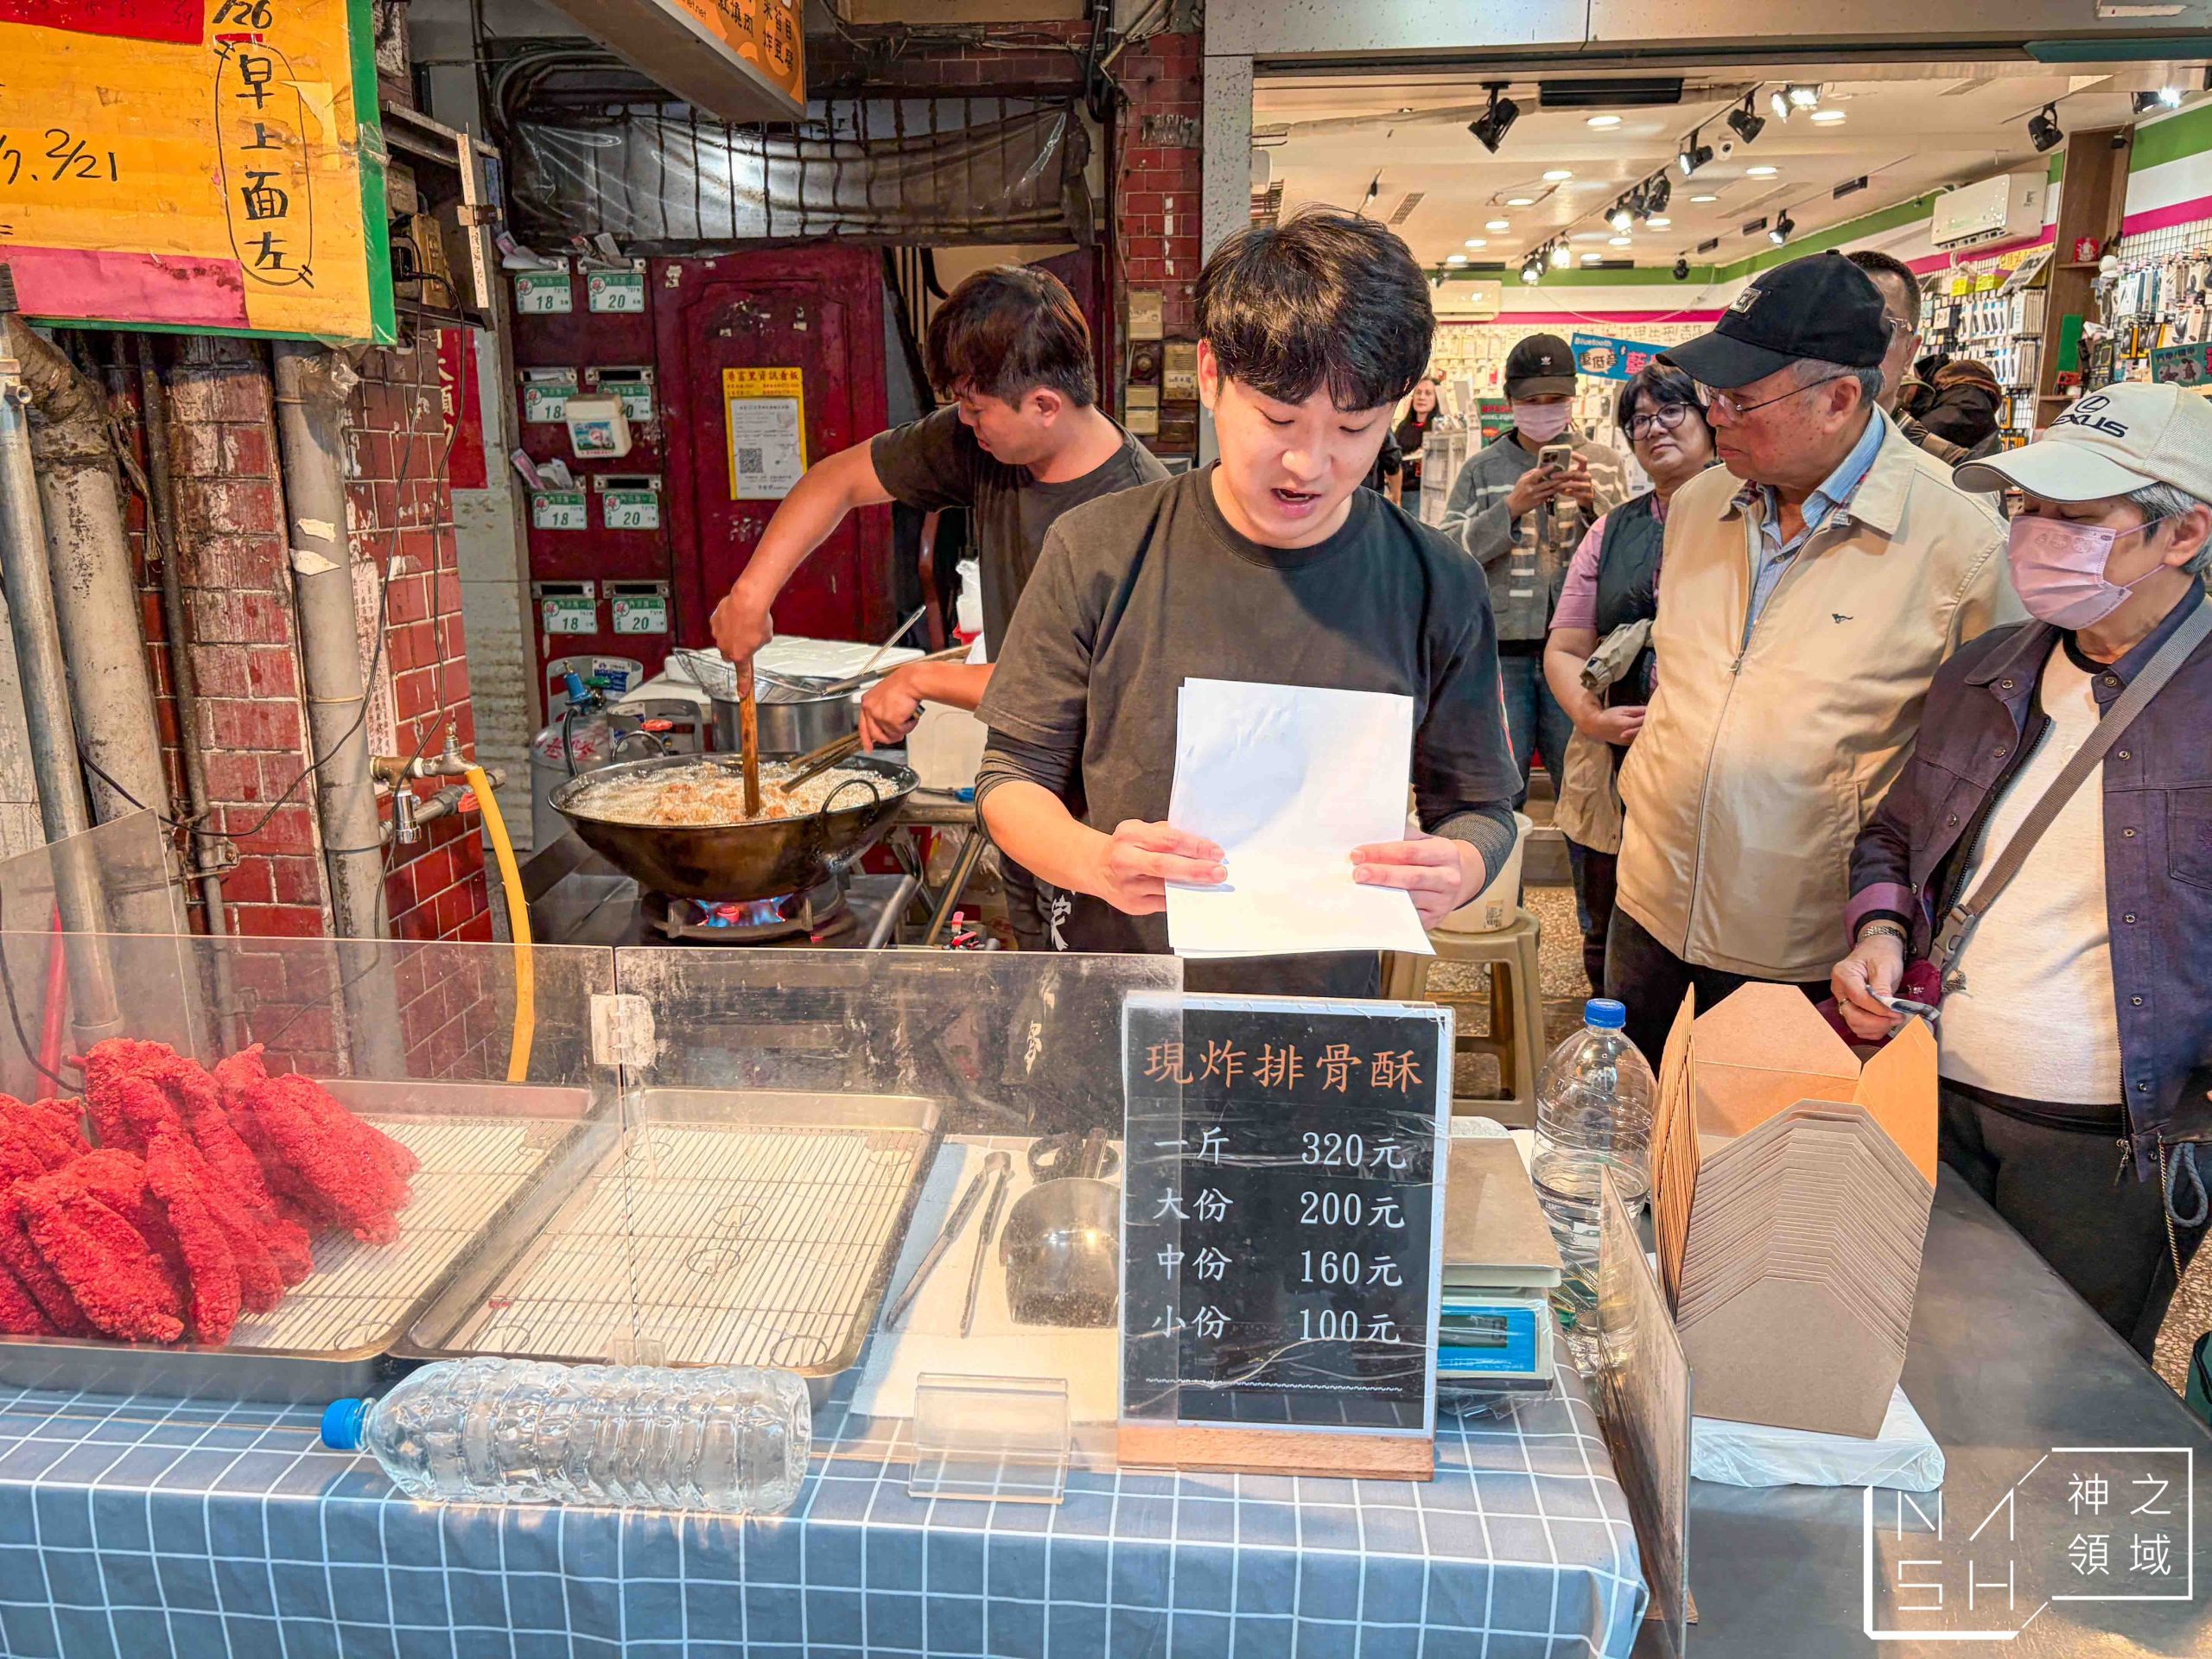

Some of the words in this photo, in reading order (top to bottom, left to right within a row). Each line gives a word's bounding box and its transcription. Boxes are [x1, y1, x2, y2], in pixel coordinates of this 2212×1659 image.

[536, 295, 554, 309] 18
[608, 294, 626, 308] 20
[544, 405, 562, 419] 18
[2050, 414, 2129, 438] EXUS
[552, 512, 569, 525] 18
[623, 512, 640, 525] 20
[563, 617, 579, 630] 18
[632, 616, 650, 630] 20
[1143, 1039, 1425, 1094] 現炸排骨酥
[1154, 1126, 1230, 1166] 一斤
[1300, 1131, 1408, 1170] 320元
[1153, 1186, 1234, 1223] 大份
[1299, 1191, 1406, 1230] 200元
[1156, 1243, 1233, 1281] 中份
[1300, 1250, 1403, 1287] 160元
[1151, 1305, 1232, 1340] 小份
[1300, 1309, 1402, 1344] 100元
